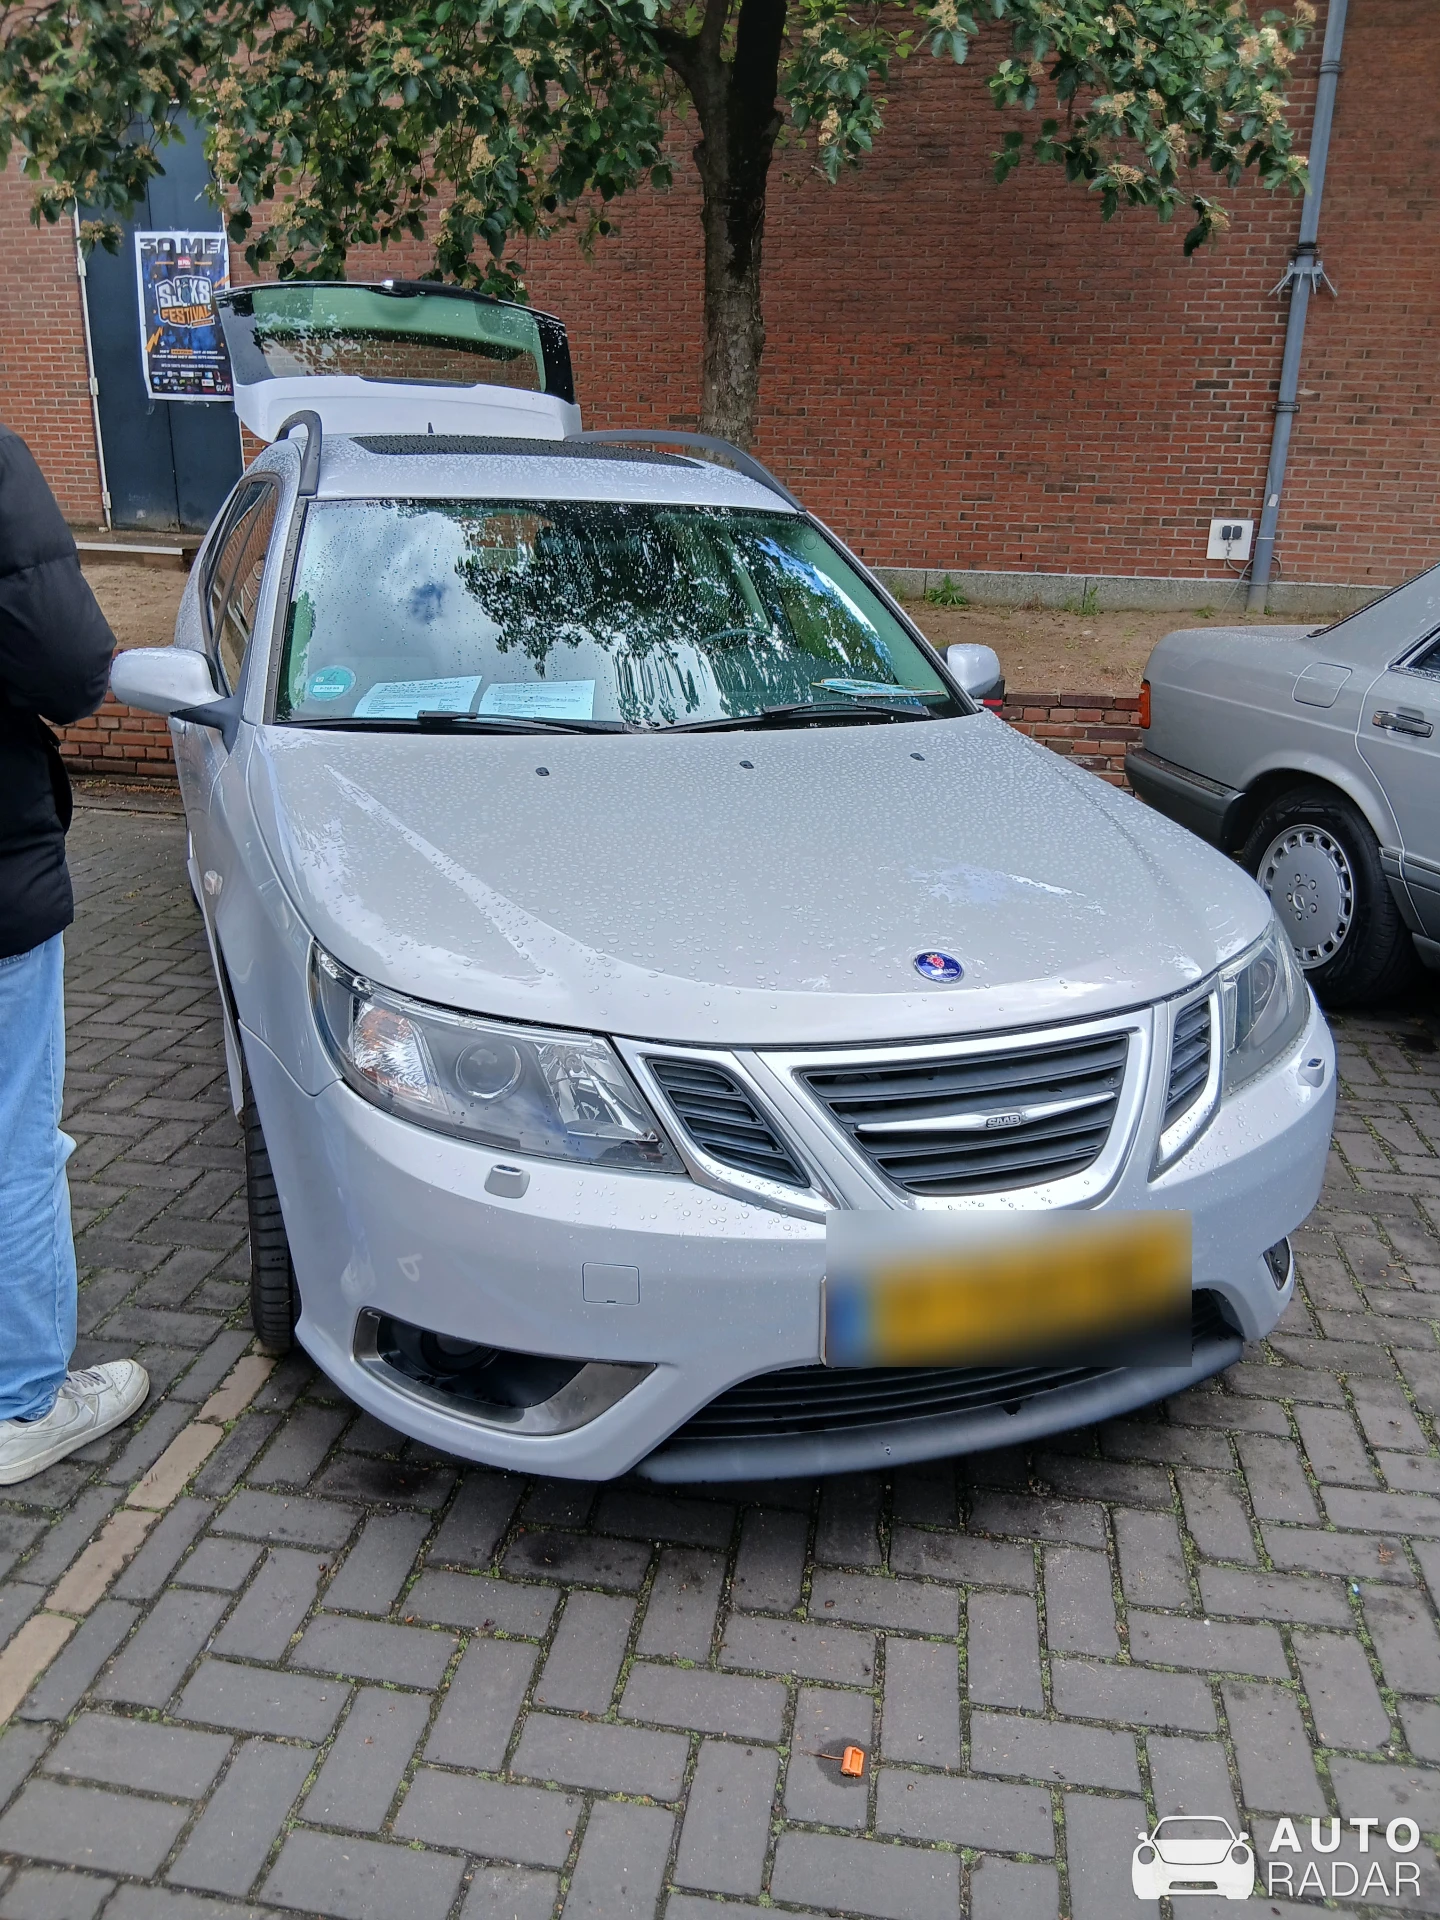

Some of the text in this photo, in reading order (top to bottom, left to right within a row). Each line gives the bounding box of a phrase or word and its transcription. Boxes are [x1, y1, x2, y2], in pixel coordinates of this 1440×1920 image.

[140, 238, 226, 254] 30 MEI
[161, 304, 211, 324] FESTIVAL
[987, 1115, 1020, 1128] SAAB
